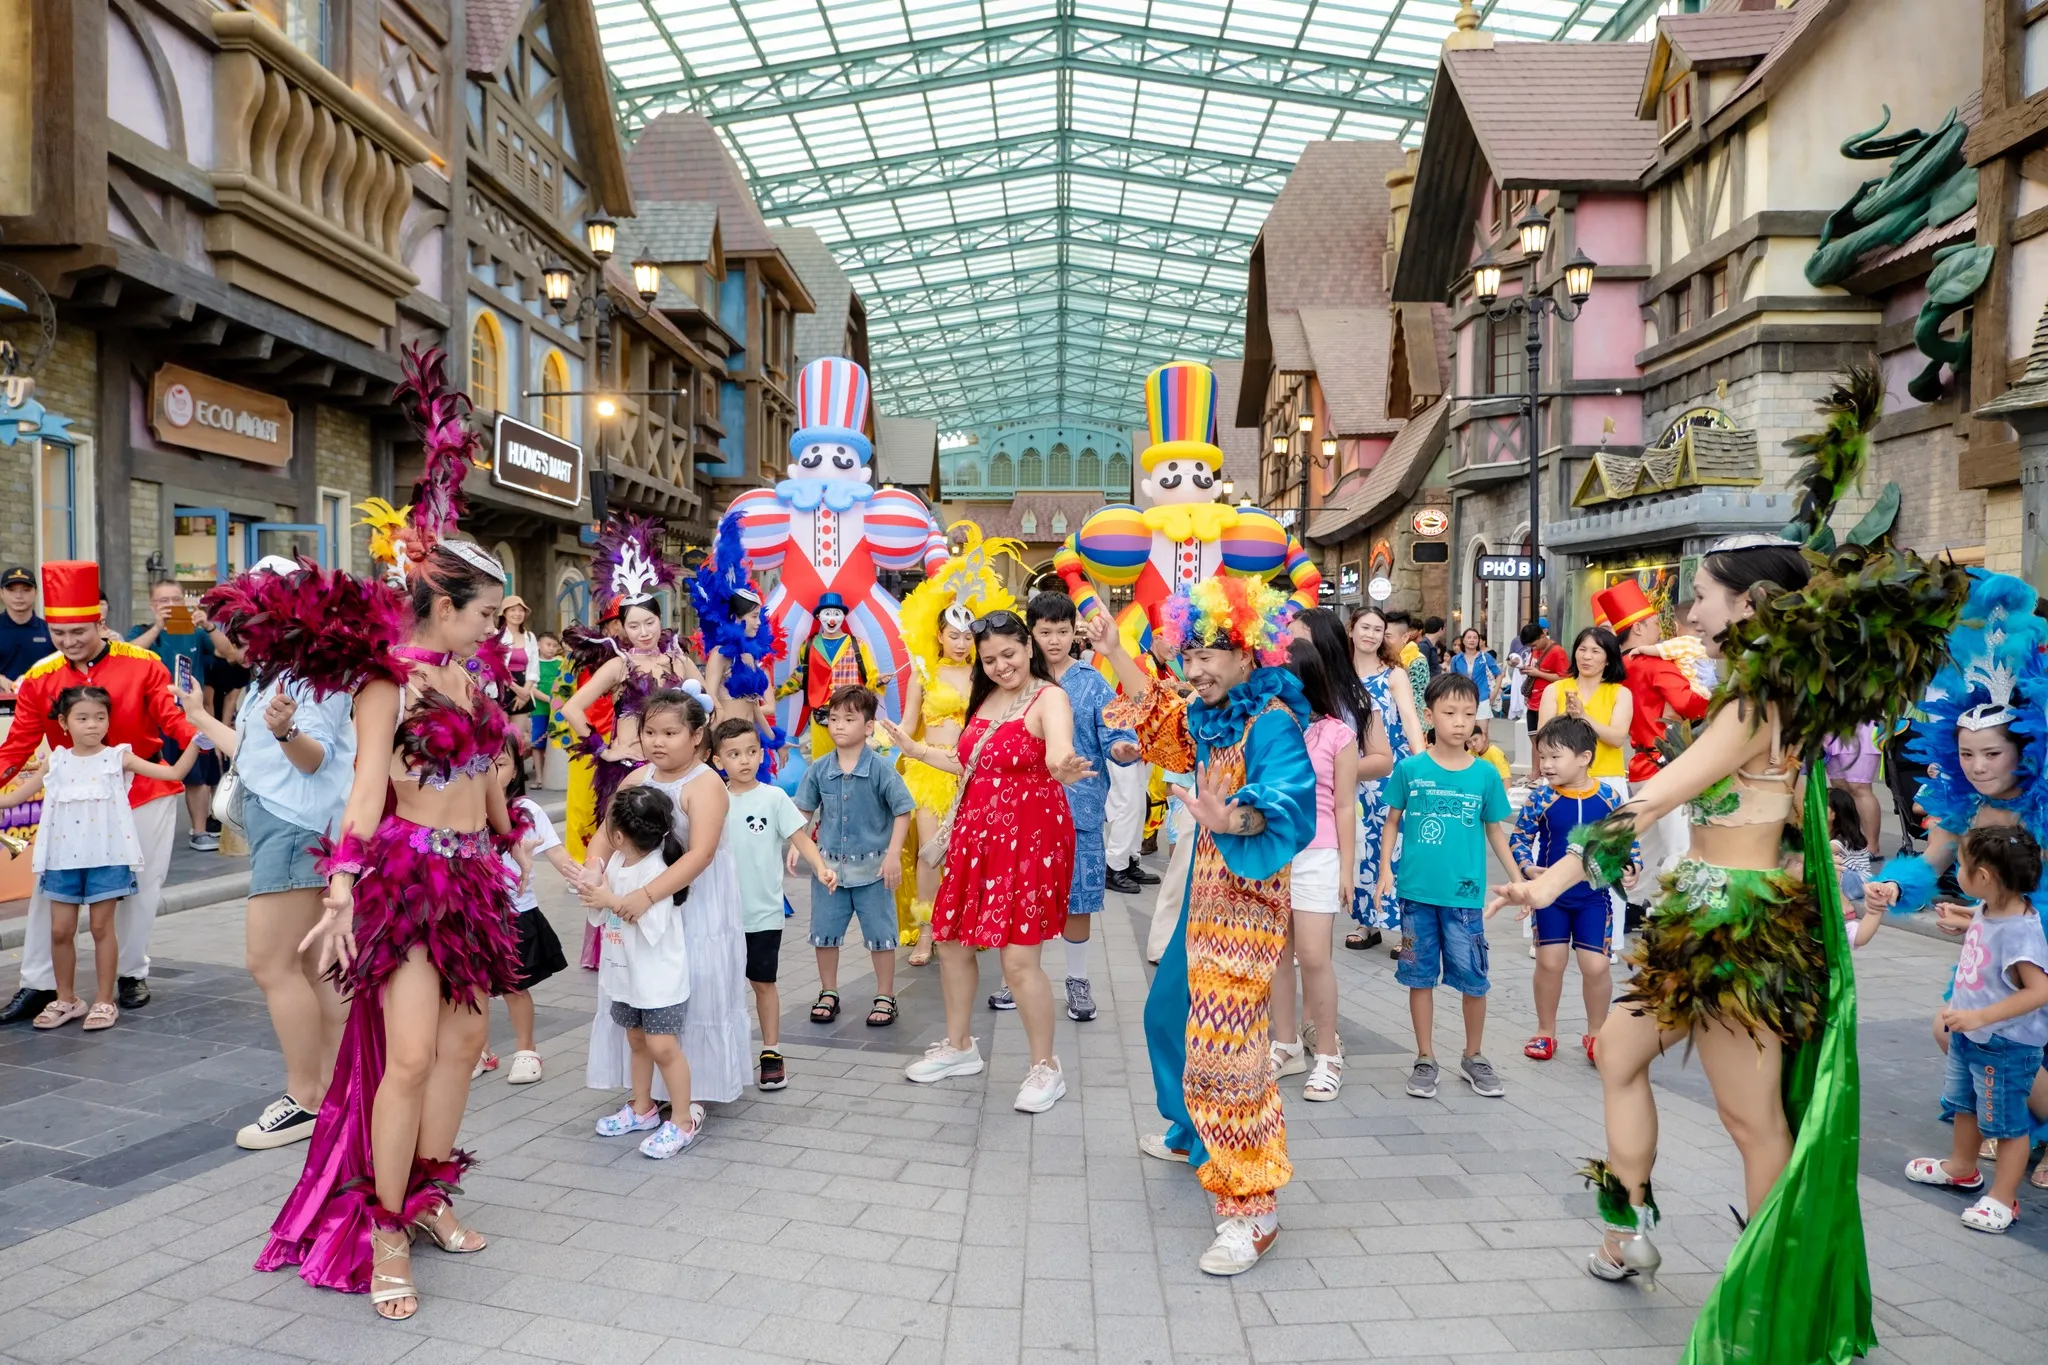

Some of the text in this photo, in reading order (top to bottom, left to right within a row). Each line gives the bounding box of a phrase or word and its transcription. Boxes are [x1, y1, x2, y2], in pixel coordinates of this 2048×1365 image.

[196, 400, 234, 431] ECO
[236, 411, 280, 443] MART
[548, 456, 573, 483] MART
[1482, 557, 1542, 577] PHỞ B
[1984, 1065, 1995, 1122] GUESS
